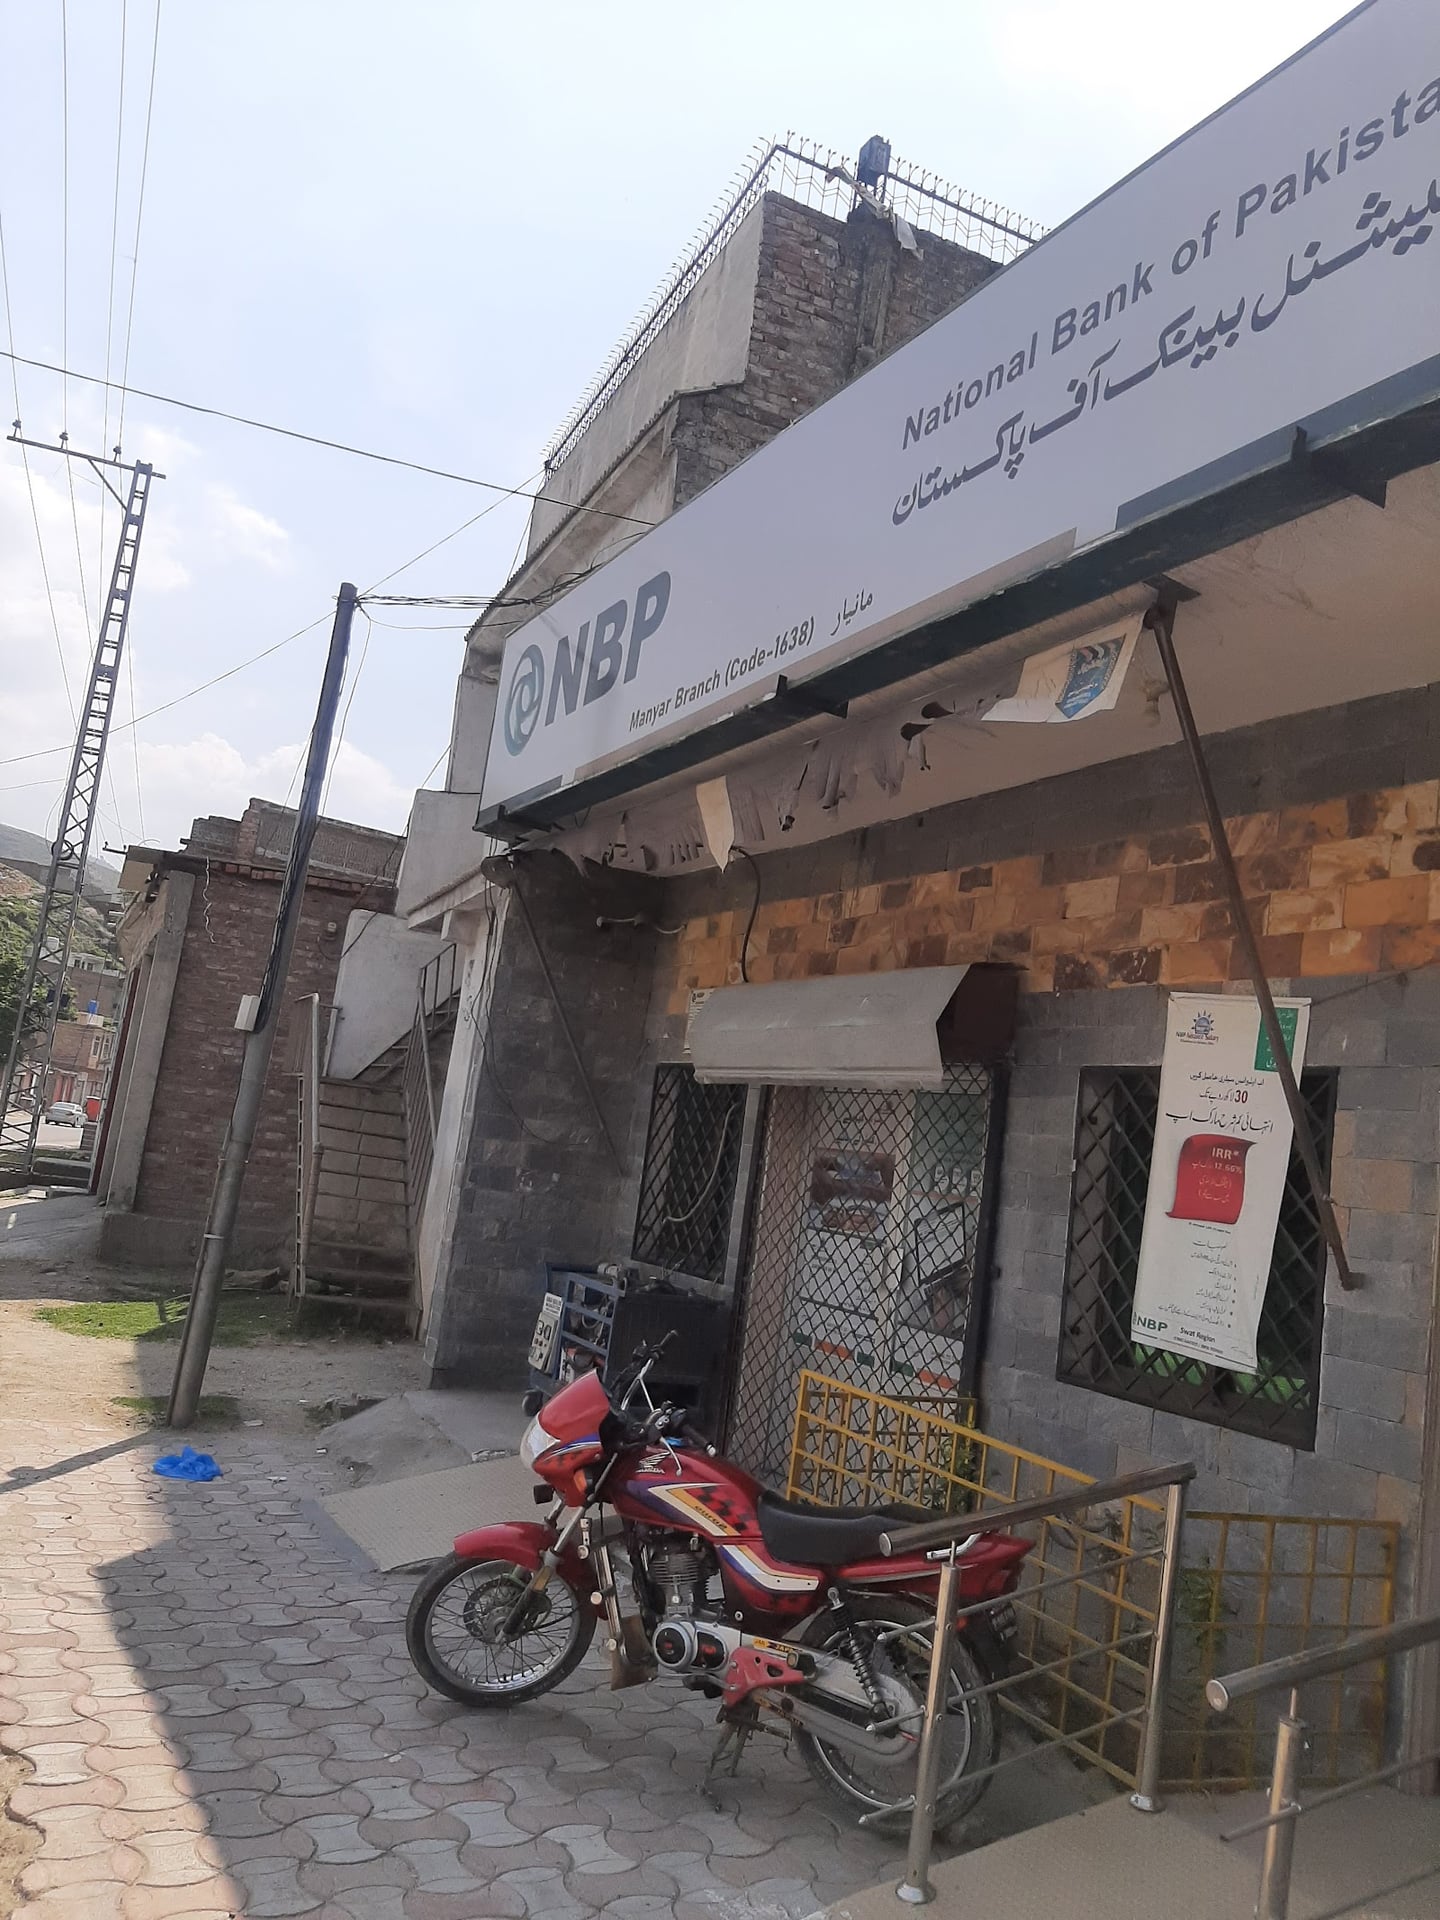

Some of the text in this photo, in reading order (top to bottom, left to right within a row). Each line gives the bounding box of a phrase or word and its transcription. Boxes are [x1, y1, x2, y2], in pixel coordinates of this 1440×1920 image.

[902, 331, 1038, 450] National
[1051, 262, 1154, 355] Bank
[1172, 210, 1221, 275] of
[1104, 297, 1245, 401] بینک
[1029, 339, 1121, 444] آف
[892, 410, 1026, 526] پاکستان
[545, 571, 671, 726] NBP
[830, 588, 873, 636] مانیار
[630, 616, 815, 732] Manyar Branch (Code-1638)
[1234, 1089, 1248, 1103] 30
[1136, 1313, 1168, 1332] NBP
[1180, 1327, 1197, 1339] Swat
